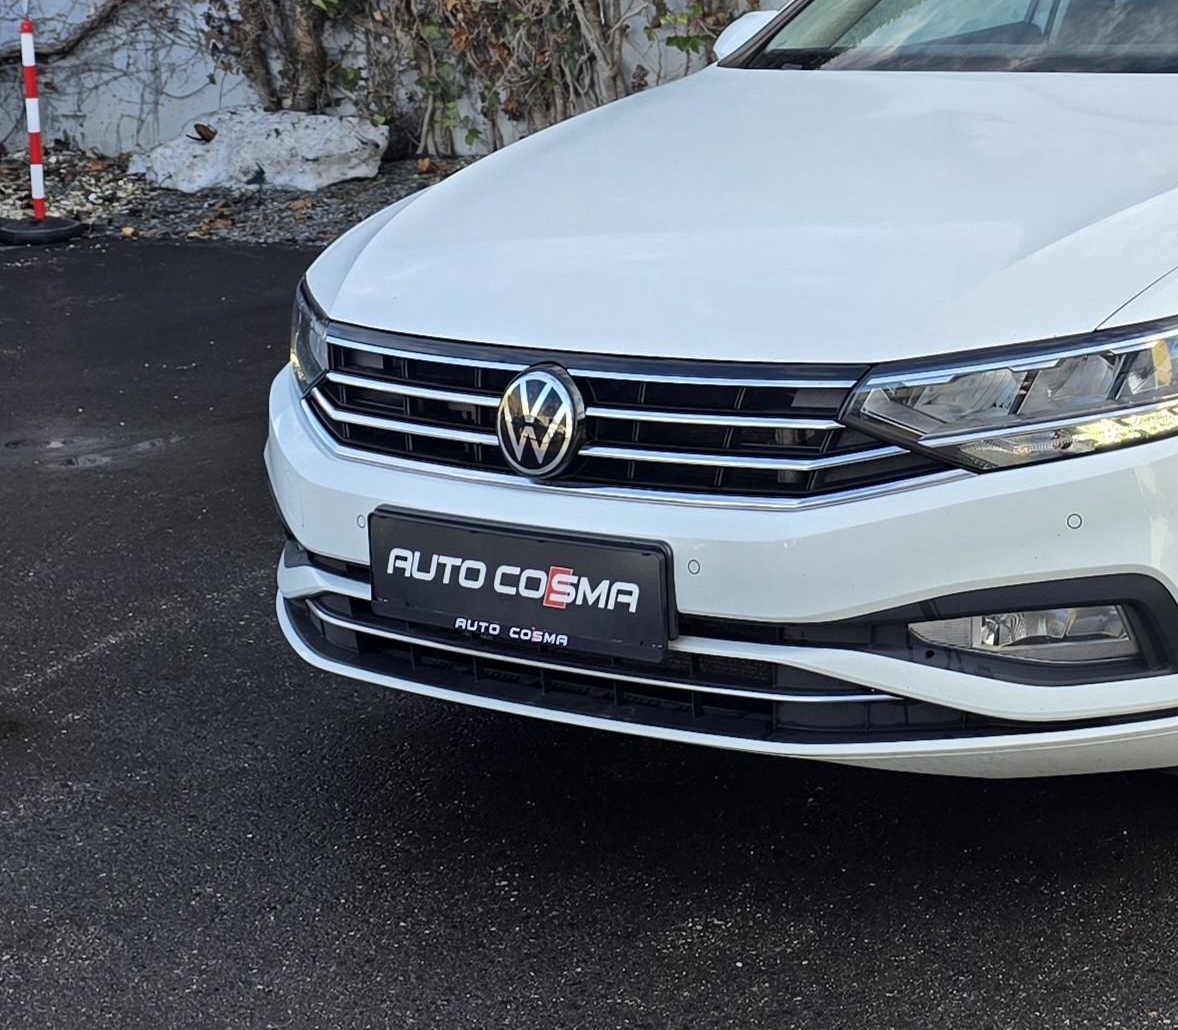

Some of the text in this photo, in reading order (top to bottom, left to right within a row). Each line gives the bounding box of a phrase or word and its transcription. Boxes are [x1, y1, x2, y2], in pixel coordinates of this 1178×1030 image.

[387, 547, 640, 613] AUTO COSMA
[455, 616, 569, 647] AUTO COSMA
